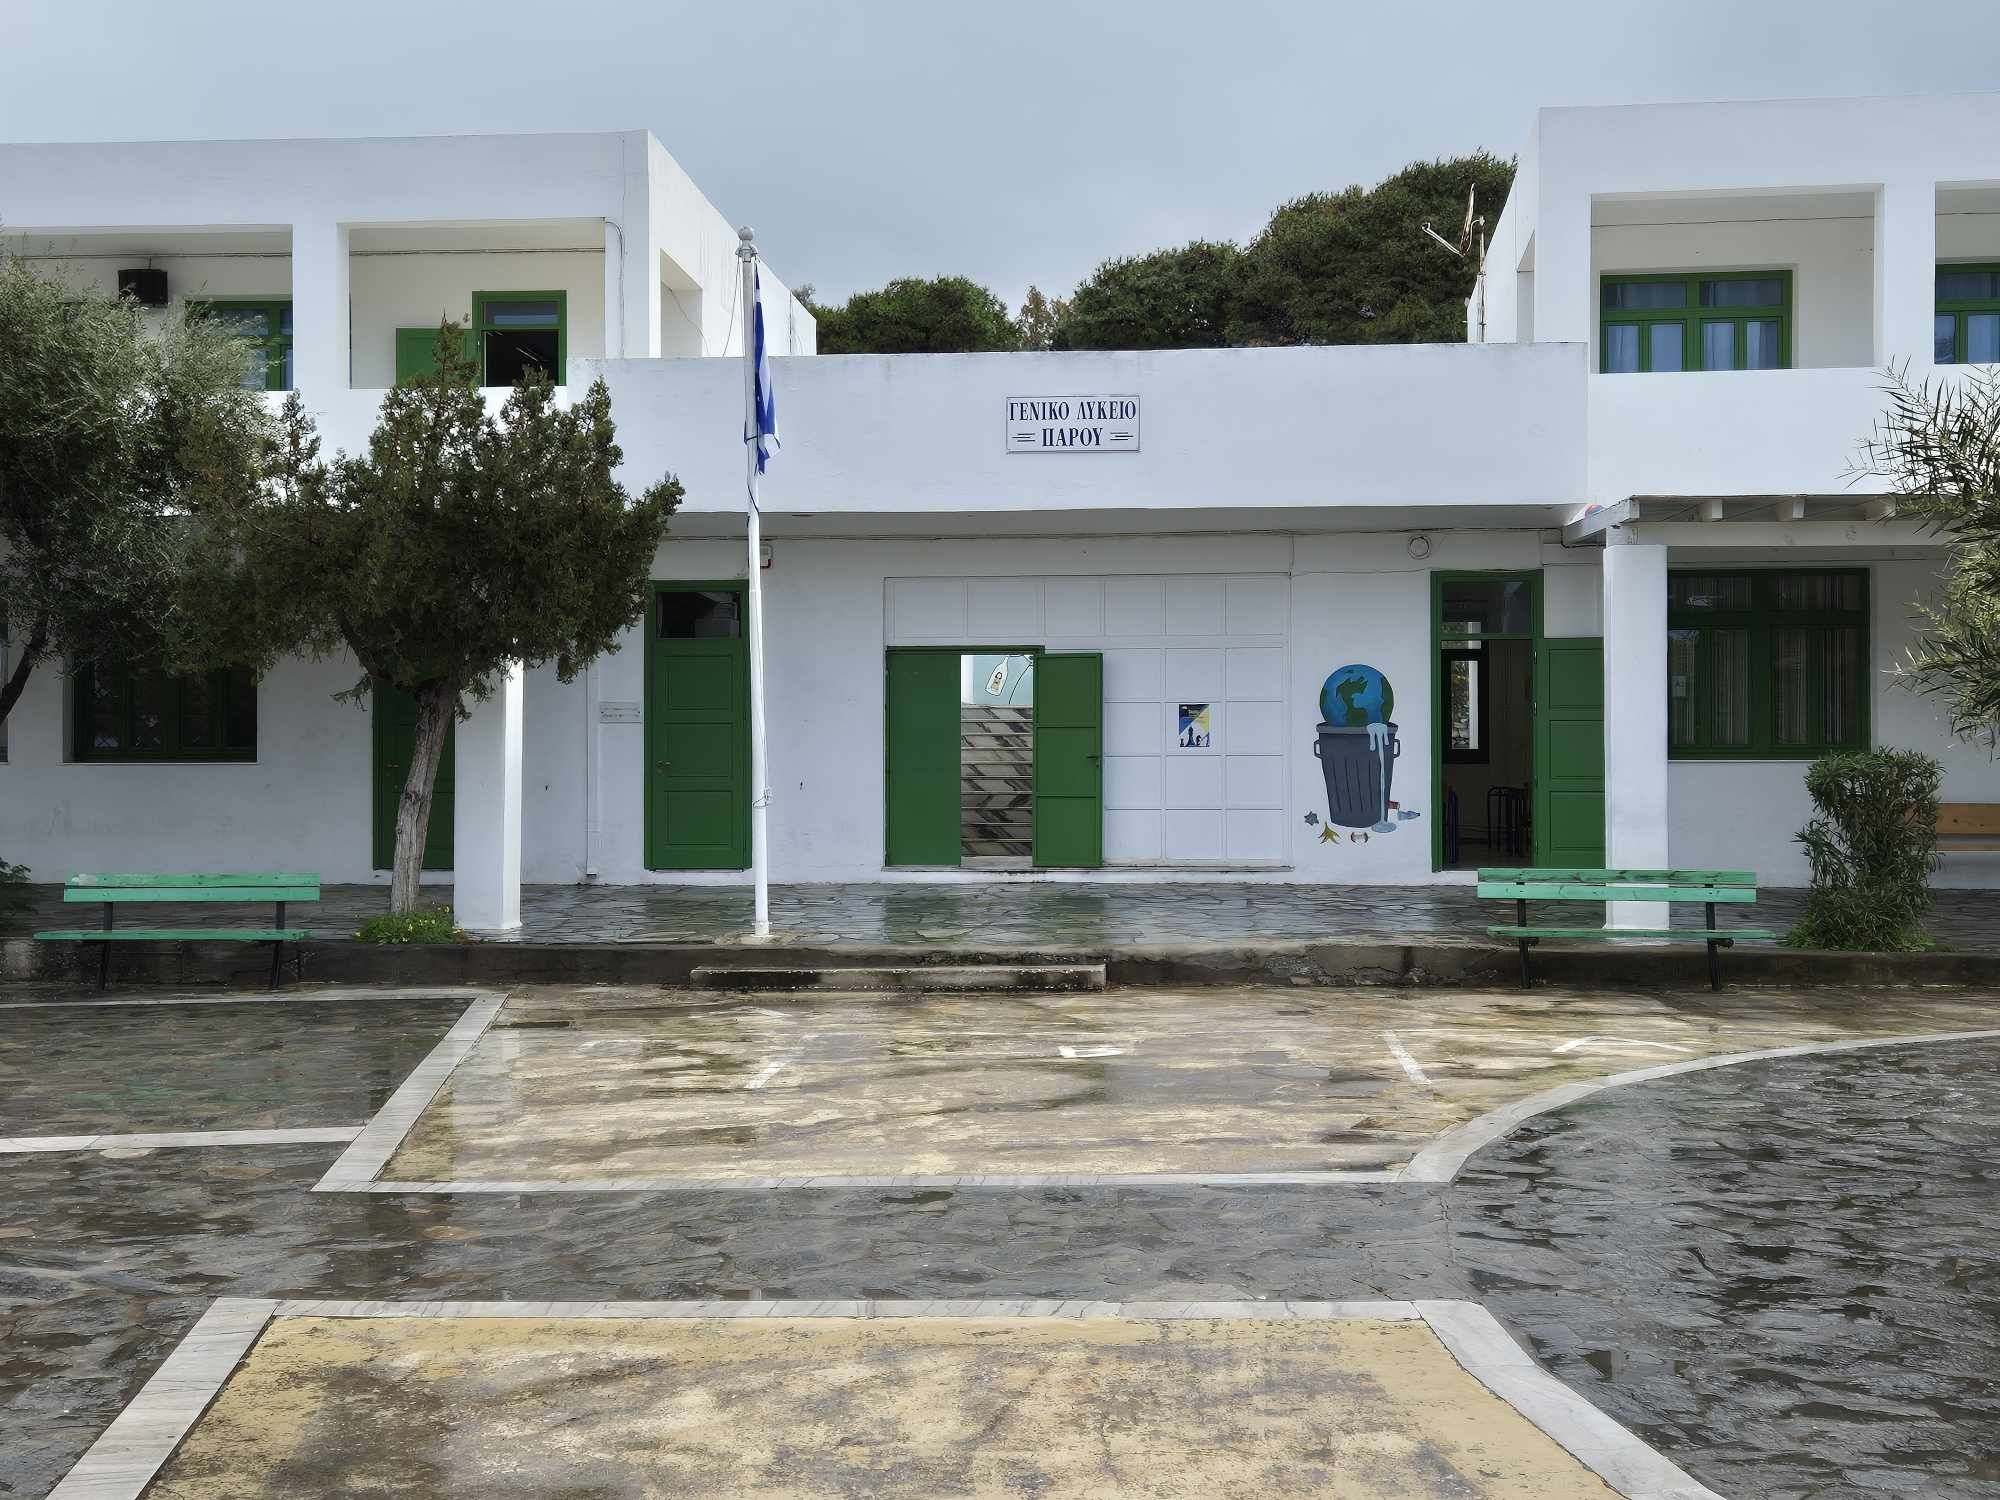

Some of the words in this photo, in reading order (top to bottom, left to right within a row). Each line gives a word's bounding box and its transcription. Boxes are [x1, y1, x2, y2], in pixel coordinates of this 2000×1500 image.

[1009, 401, 1070, 421] ΓΕΝΙΚΟ
[1077, 400, 1137, 420] ΛΥΚΕΙΟ
[1042, 427, 1103, 447] ΠΑΡΟΥ
